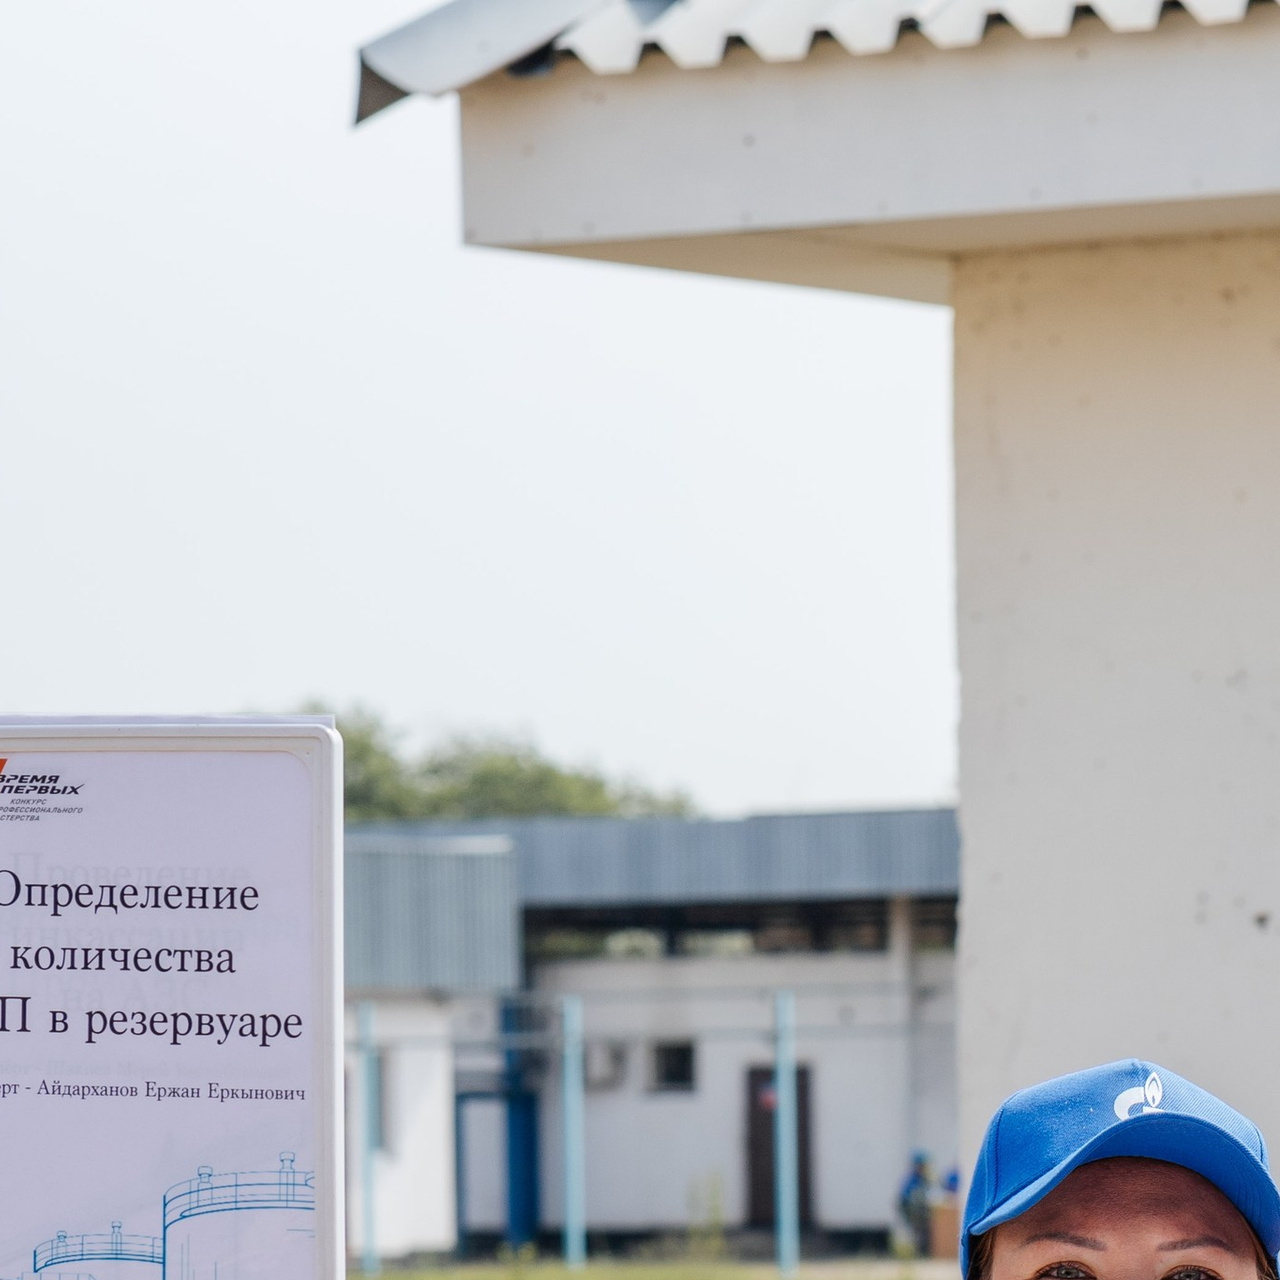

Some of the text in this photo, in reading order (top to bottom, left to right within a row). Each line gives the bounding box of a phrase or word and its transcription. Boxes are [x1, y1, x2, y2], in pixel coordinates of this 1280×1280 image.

[0, 783, 85, 795] ПЕРВЫХ
[0, 806, 83, 814] РОФЕССИОНАЛЬНОГО
[0, 869, 259, 916] Определение
[10, 945, 236, 973] количества
[0, 996, 303, 1047] П в резервуаре
[0, 1083, 20, 1098] рт
[37, 1079, 138, 1099] Айдарханов
[145, 1081, 201, 1101] Ержан
[207, 1082, 306, 1102] Еркынович
